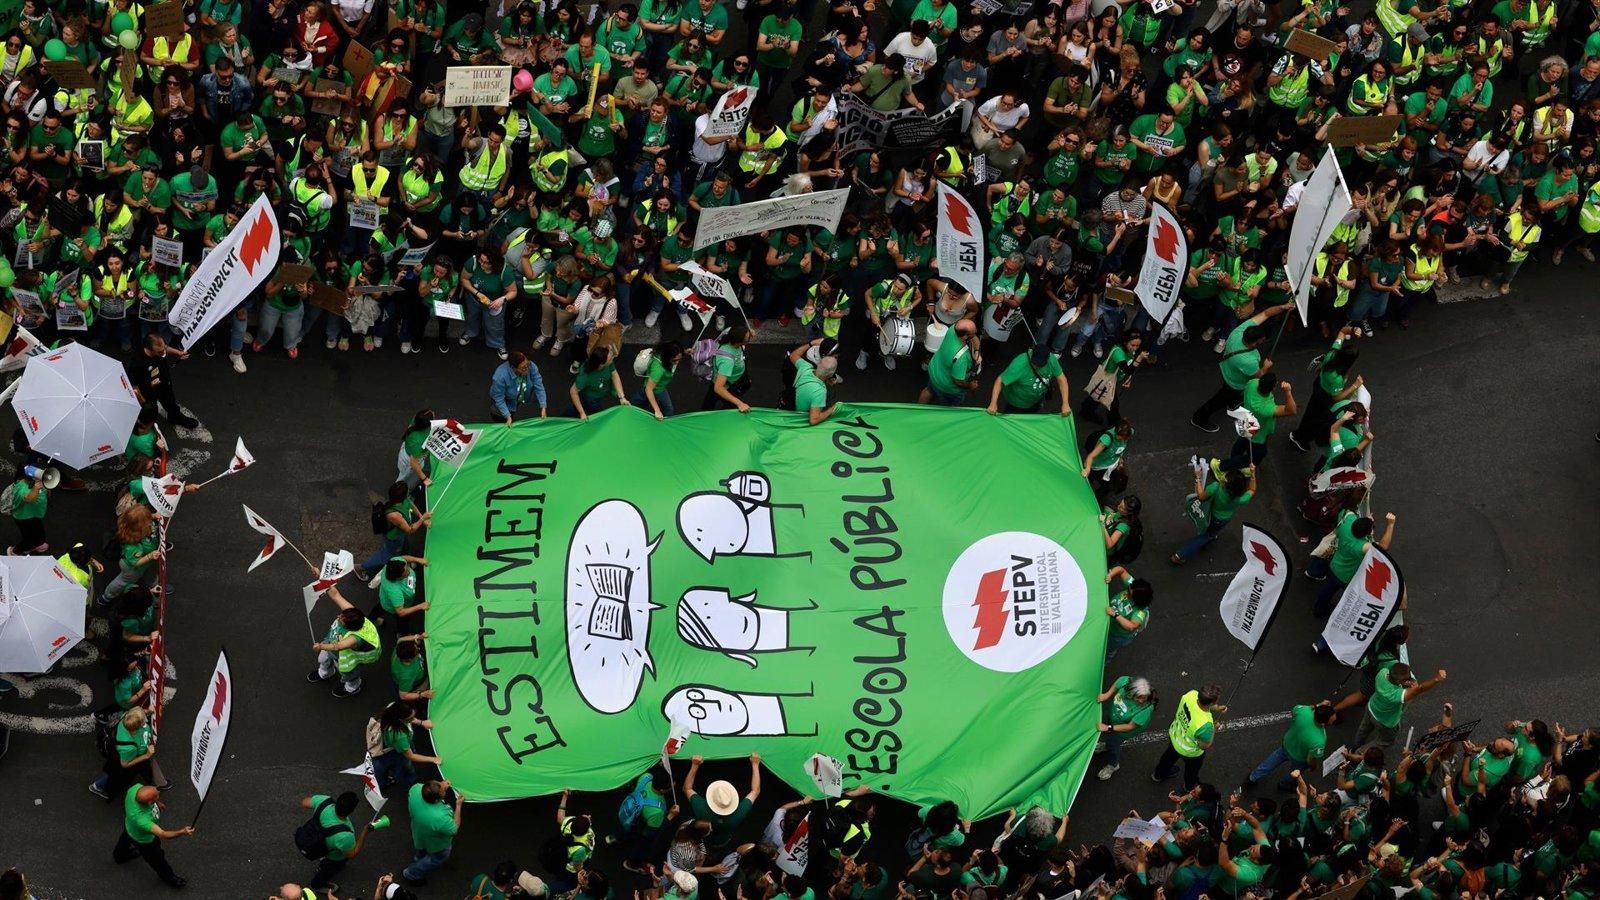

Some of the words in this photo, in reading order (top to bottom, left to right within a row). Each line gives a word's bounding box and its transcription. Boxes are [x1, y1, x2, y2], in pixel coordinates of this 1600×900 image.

[473, 458, 567, 765] ESTIMEM
[1011, 554, 1037, 637] STEPV
[1036, 552, 1050, 635] INTERSINDICAL
[1047, 550, 1062, 621] VALENCIANA
